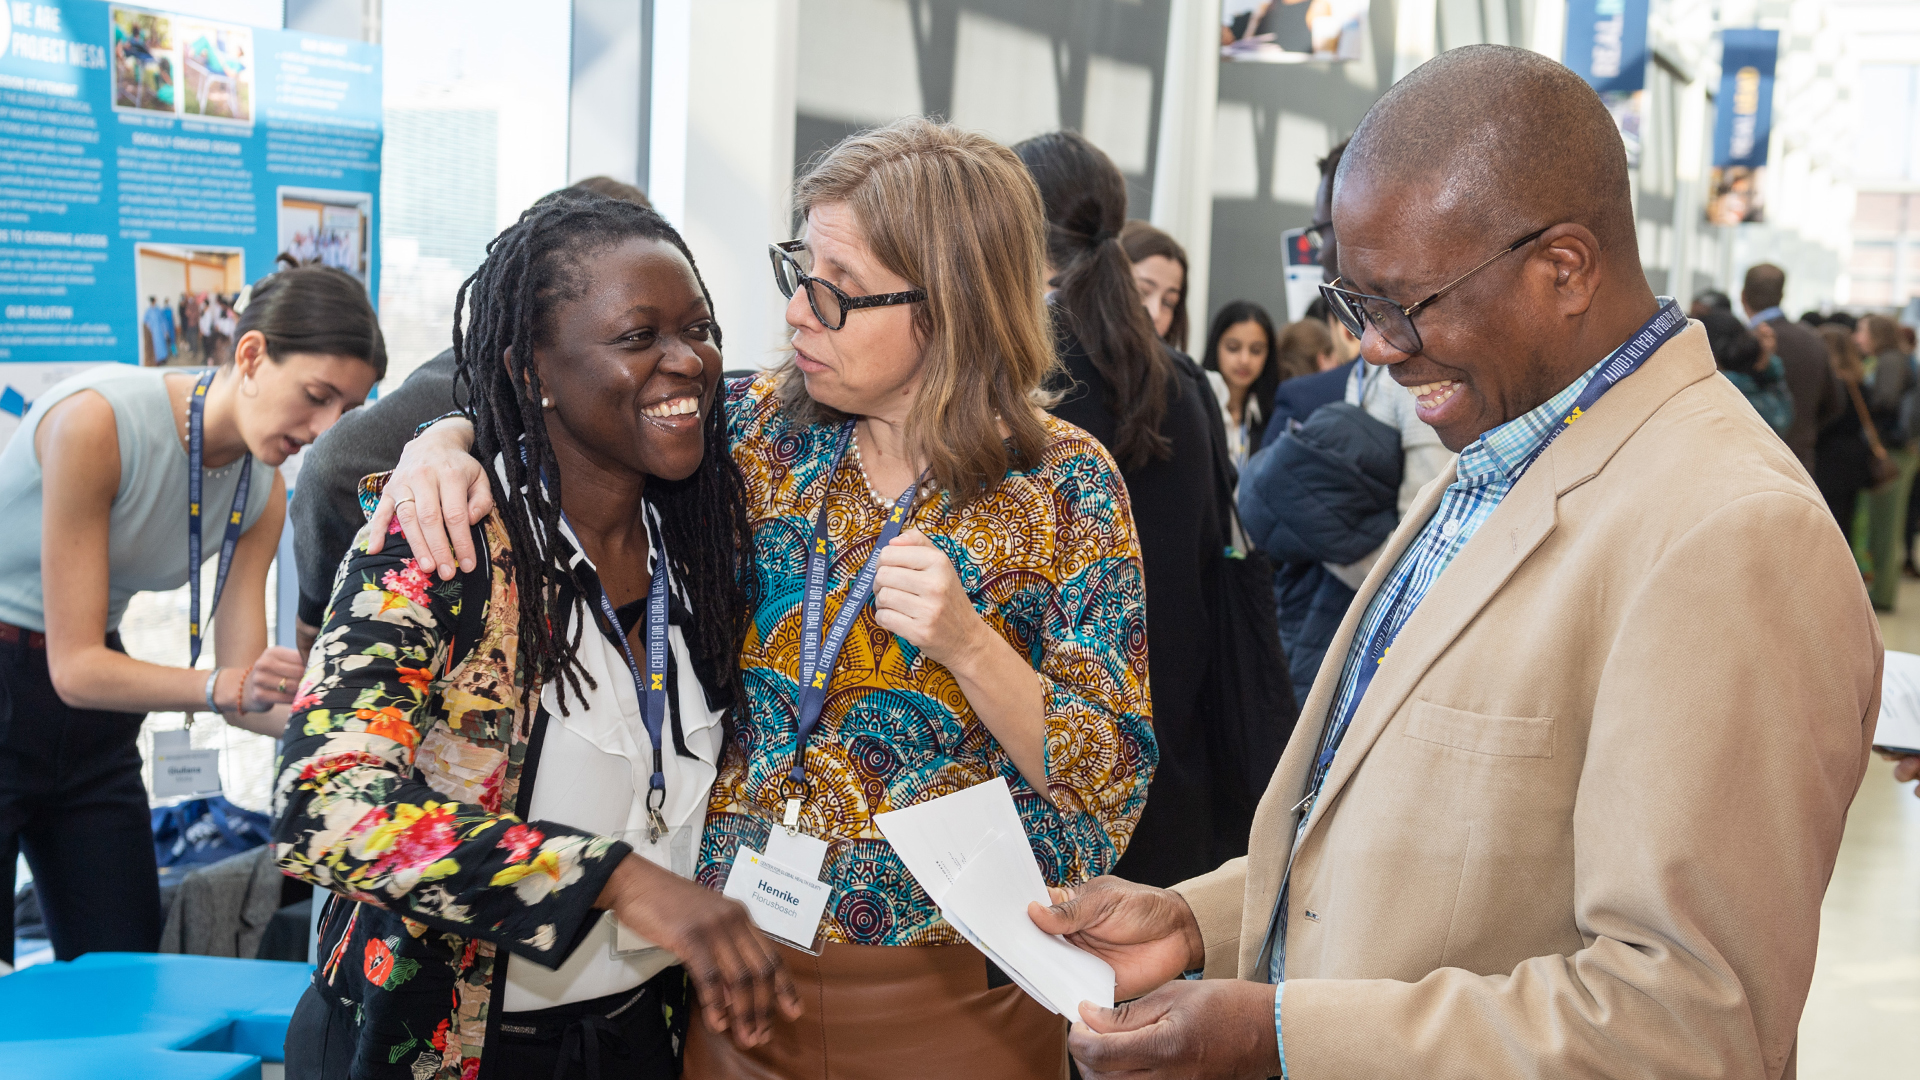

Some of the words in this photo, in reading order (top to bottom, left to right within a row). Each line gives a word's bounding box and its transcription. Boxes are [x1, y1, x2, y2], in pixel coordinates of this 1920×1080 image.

[1649, 311, 1676, 336] GLOBAL
[1625, 329, 1658, 360] HEALTH
[1602, 354, 1634, 385] EQUITY
[890, 505, 904, 524] M
[815, 537, 826, 555] M
[811, 557, 826, 585] CENTER
[809, 586, 823, 601] FOR
[651, 595, 665, 623] GLOBAL
[806, 602, 821, 630] GLOBAL
[651, 624, 665, 640] FOR
[811, 670, 827, 690] M
[819, 642, 837, 669] CENTER
[829, 625, 845, 645] FOR
[837, 599, 861, 629] GLOBAL
[851, 573, 874, 604] HEALTH
[606, 610, 624, 636] GLOBAL
[622, 638, 636, 665] HEALTH
[632, 666, 645, 692] EQUITY
[651, 641, 664, 669] CENTER
[804, 632, 818, 661] HEALTH
[651, 673, 664, 691] M
[751, 890, 798, 919] Florusbosch
[757, 879, 800, 906] Henrike
